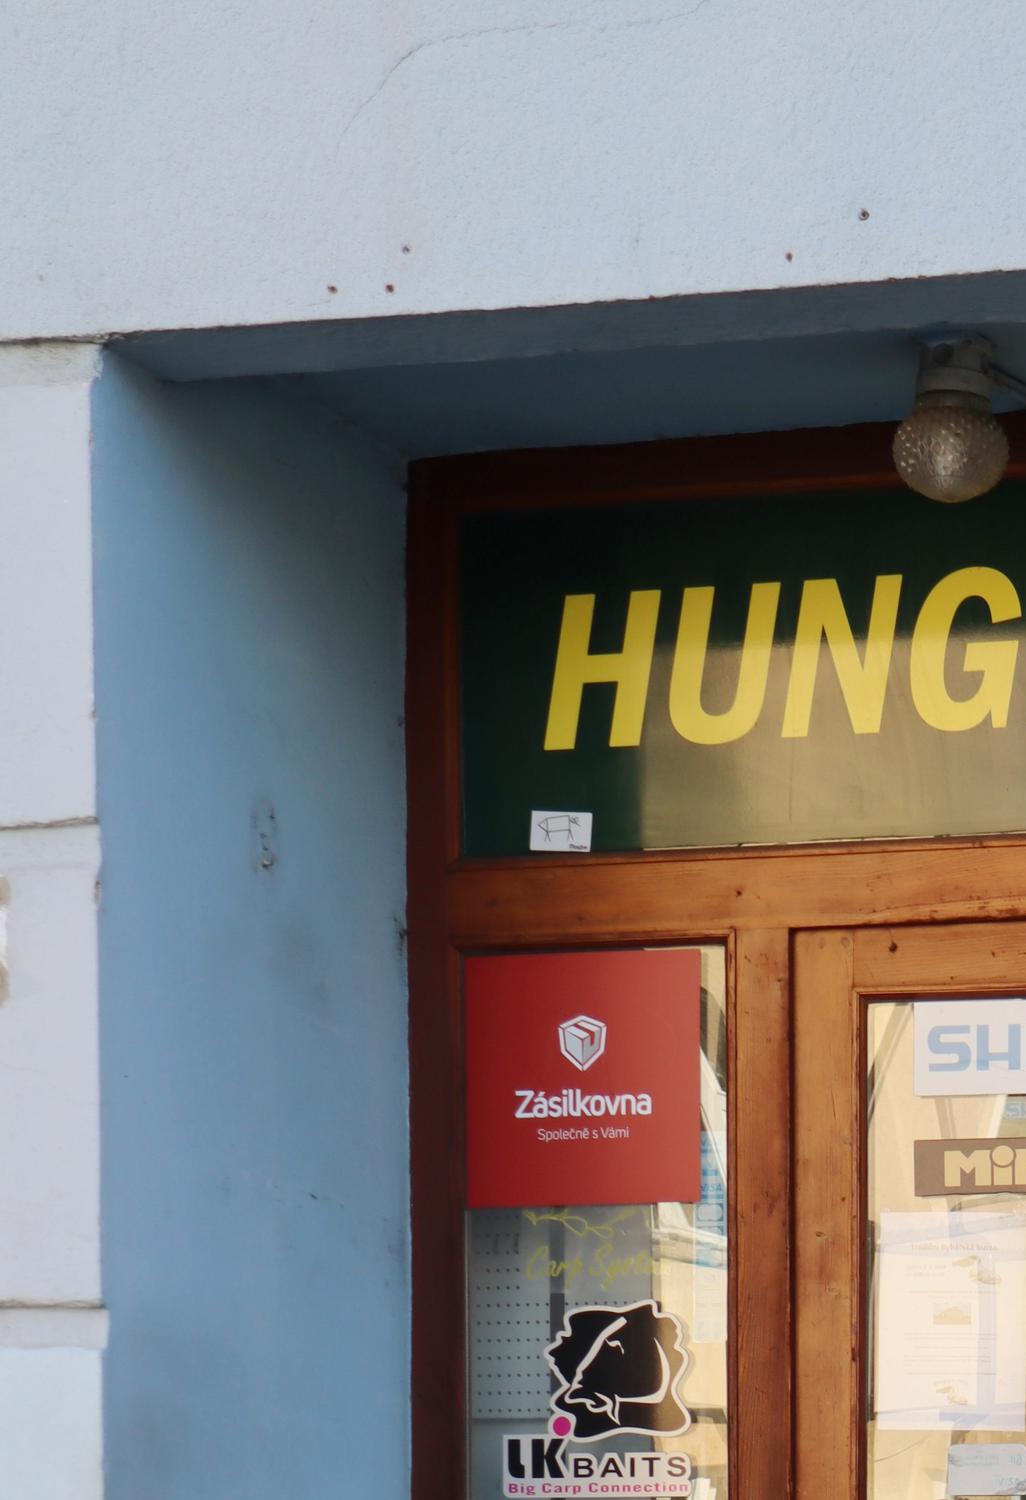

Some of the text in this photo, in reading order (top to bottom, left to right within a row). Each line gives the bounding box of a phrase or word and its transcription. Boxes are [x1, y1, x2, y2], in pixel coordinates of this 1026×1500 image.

[514, 1088, 653, 1119] Zásilkovna
[537, 1126, 629, 1142] Společně s Vámi
[508, 1482, 689, 1495] Big Carp Connection
